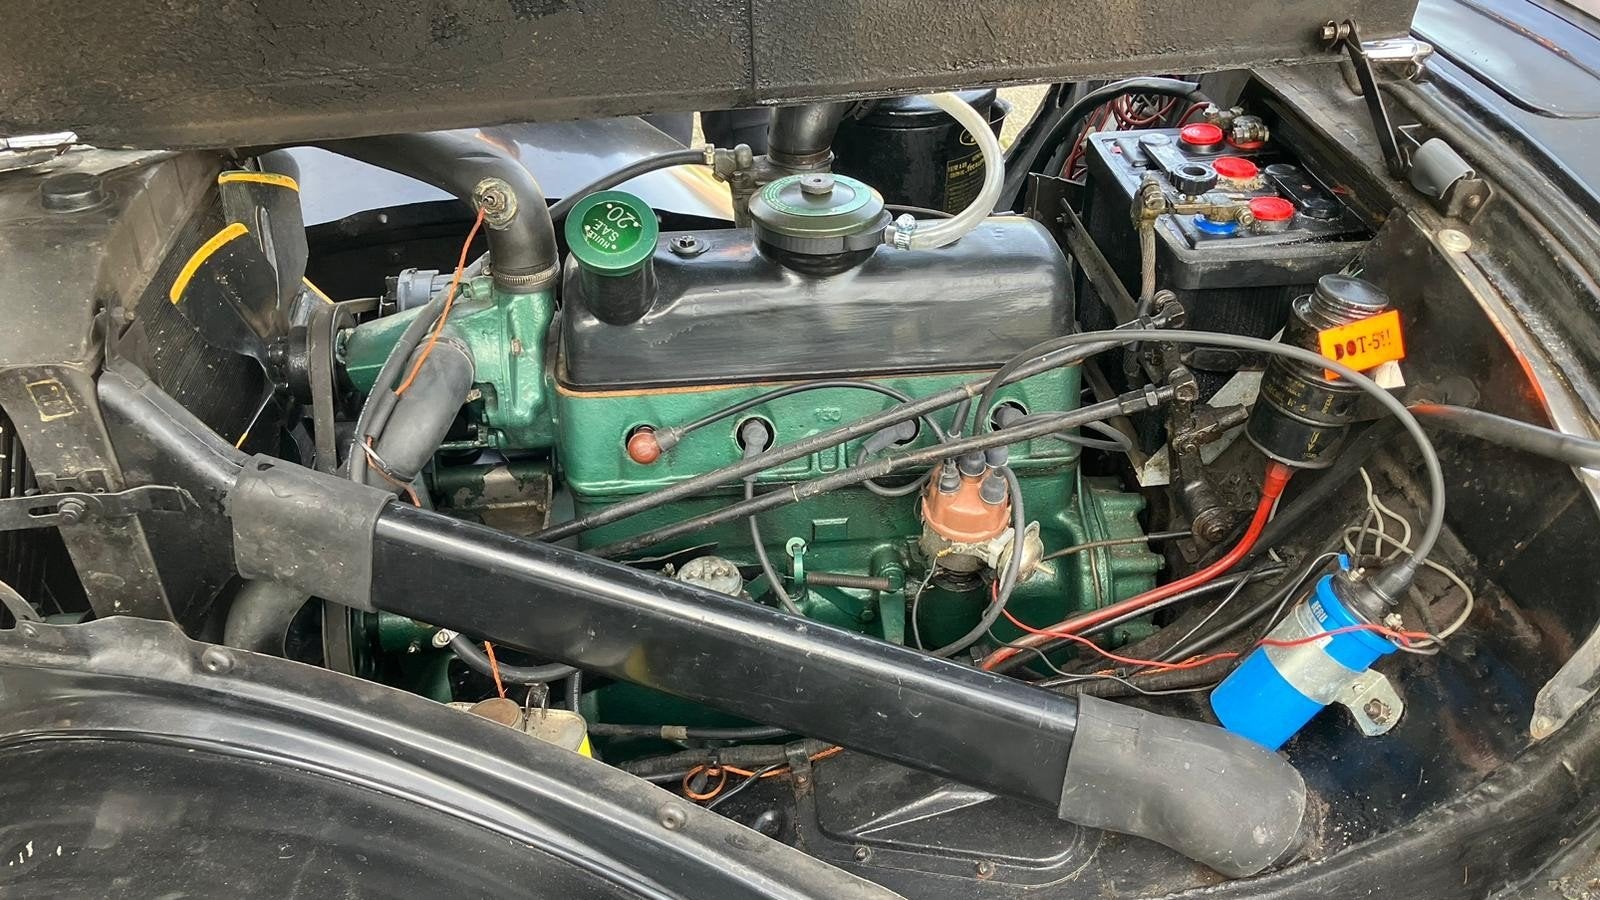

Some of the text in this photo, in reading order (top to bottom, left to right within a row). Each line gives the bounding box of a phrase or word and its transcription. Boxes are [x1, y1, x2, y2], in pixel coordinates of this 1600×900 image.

[607, 206, 637, 229] 20
[586, 229, 611, 250] HUILE
[1310, 600, 1329, 623] BERU
